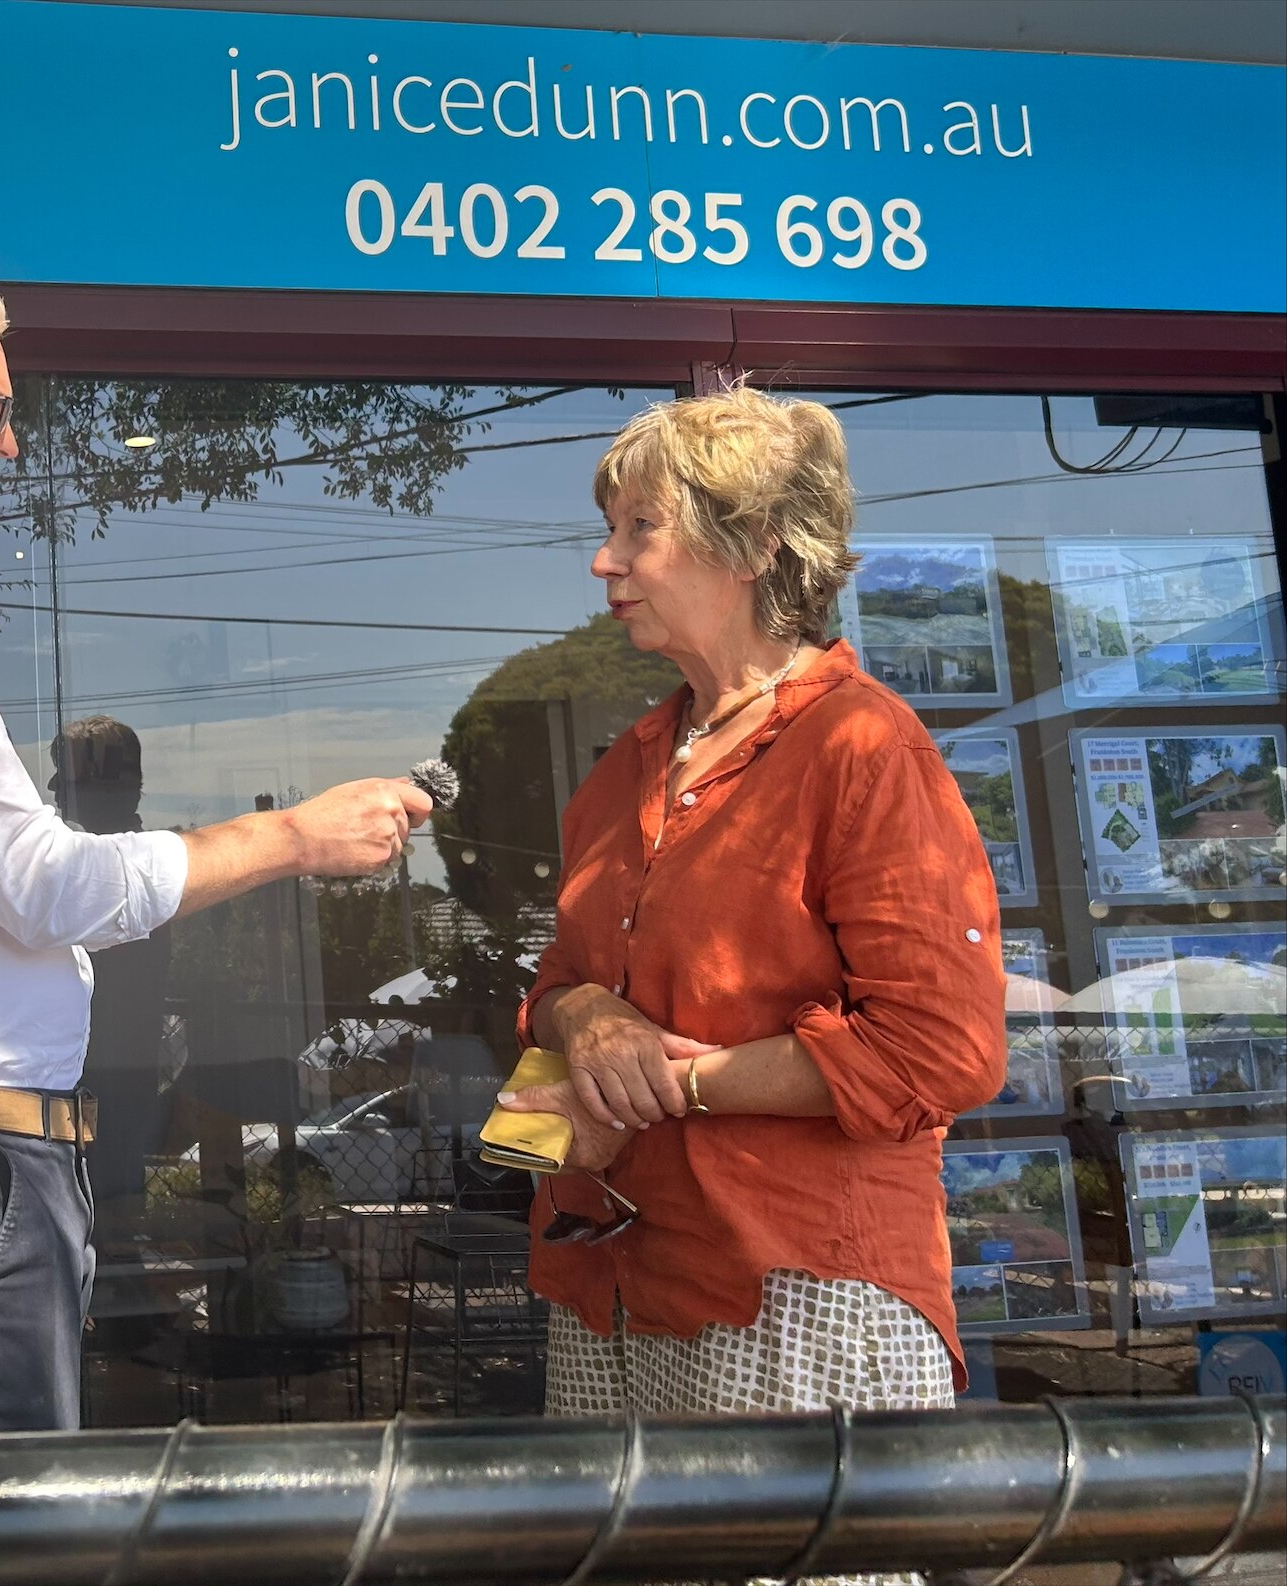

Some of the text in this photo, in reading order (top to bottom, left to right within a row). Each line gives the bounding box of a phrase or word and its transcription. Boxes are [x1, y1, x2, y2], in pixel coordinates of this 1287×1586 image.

[220, 47, 1032, 158] janicedunn.com.au
[345, 179, 927, 271] 0402 285 698
